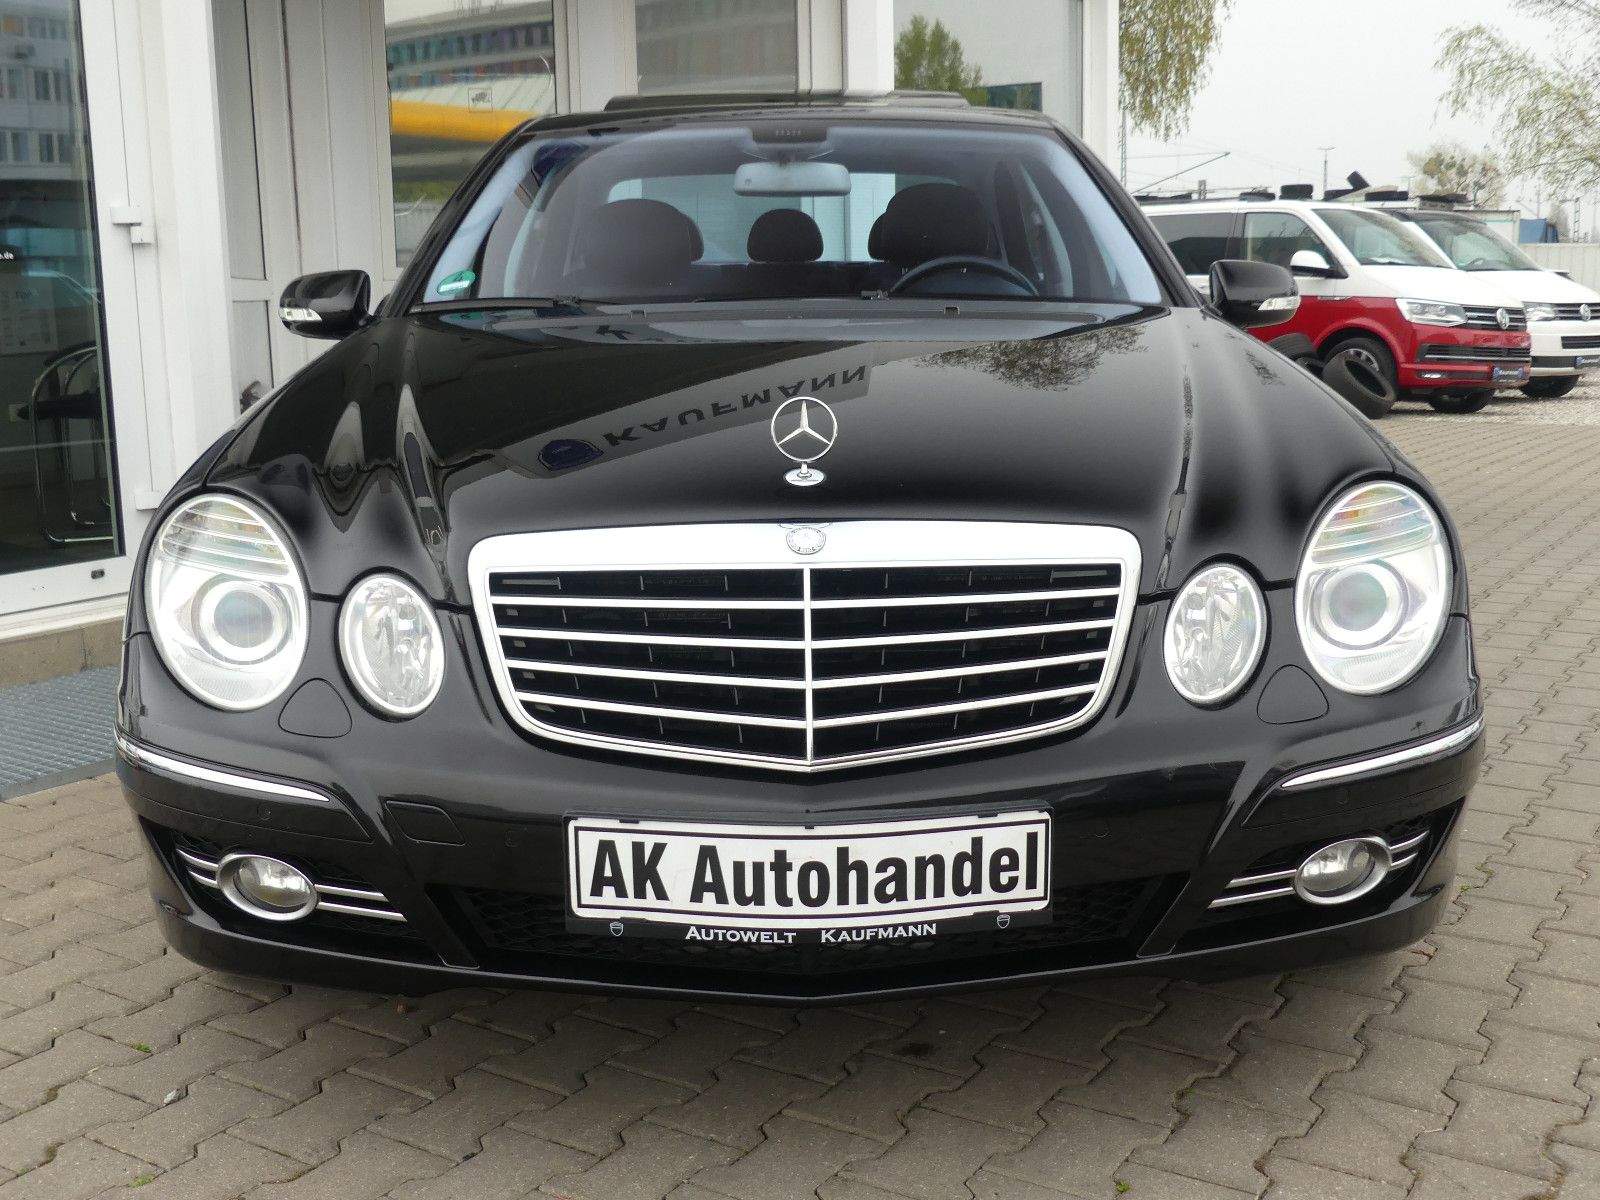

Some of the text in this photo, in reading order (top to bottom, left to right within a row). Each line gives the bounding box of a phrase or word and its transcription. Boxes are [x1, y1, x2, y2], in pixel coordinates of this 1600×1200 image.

[590, 831, 1038, 907] AK Autohandel
[685, 923, 937, 944] AUTOWELT KAUFMANN
